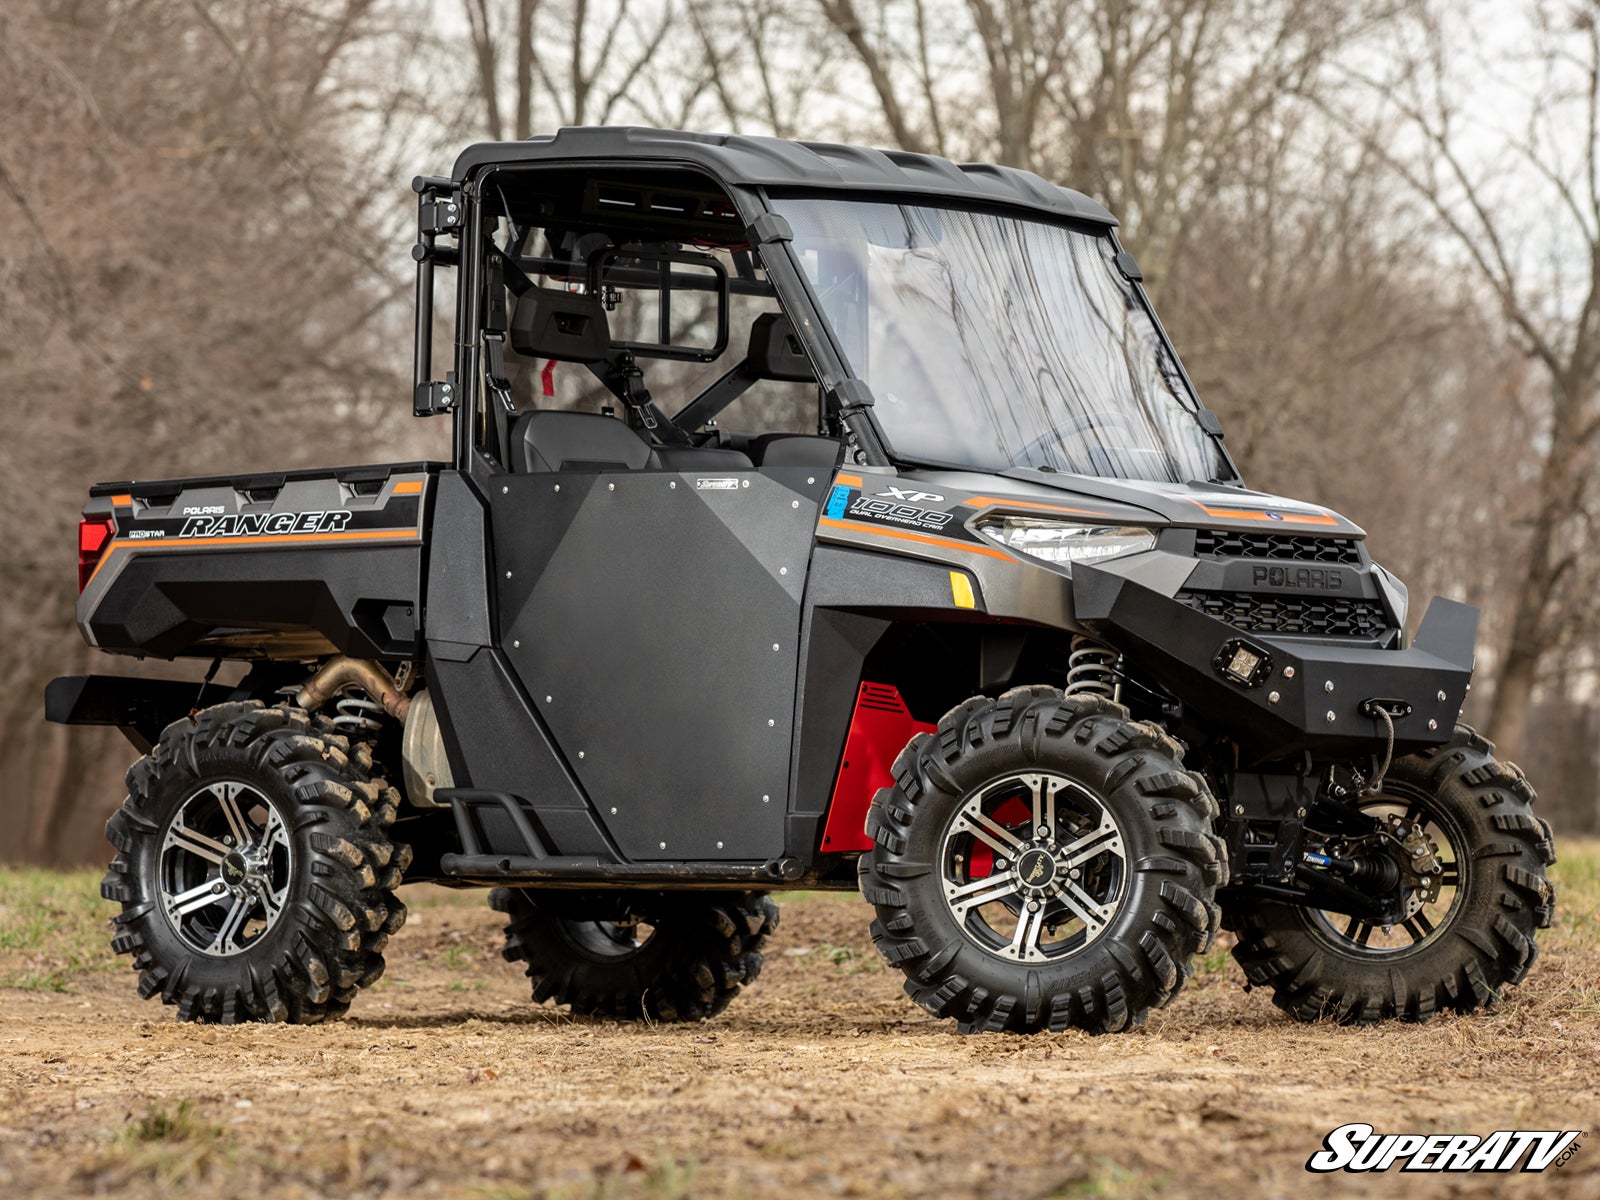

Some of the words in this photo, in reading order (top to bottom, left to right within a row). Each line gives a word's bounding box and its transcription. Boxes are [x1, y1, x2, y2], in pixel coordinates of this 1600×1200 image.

[871, 485, 946, 502] XP
[183, 506, 225, 515] POLARIS
[849, 509, 873, 517] DUAL
[874, 513, 922, 527] OVERHEAD
[922, 522, 944, 531] CAM
[851, 497, 954, 526] 1000
[179, 511, 352, 537] RANGER
[1252, 566, 1343, 591] POLARIS
